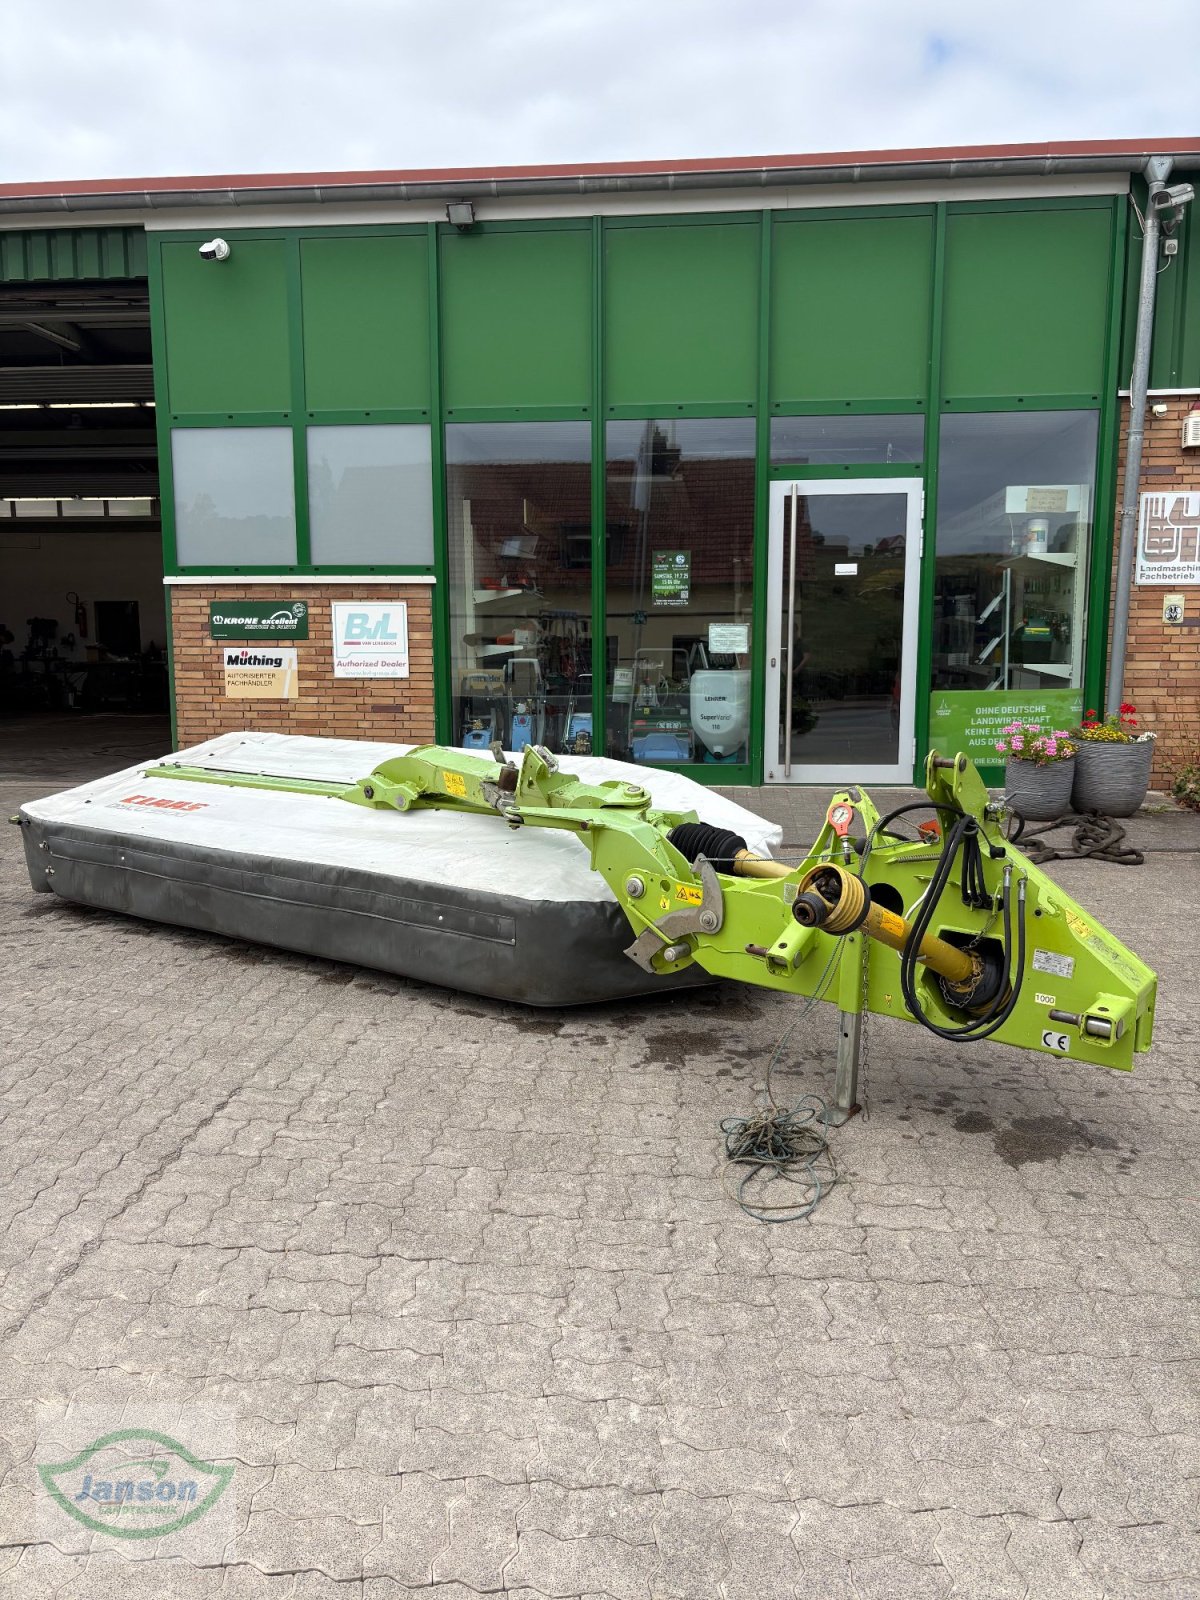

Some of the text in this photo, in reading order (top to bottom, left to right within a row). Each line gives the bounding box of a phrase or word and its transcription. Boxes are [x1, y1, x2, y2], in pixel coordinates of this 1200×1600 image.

[1140, 572, 1195, 580] Fachbetrieb
[224, 617, 298, 625] KRONE excellent
[344, 613, 398, 640] BvL
[227, 650, 283, 668] Müthing
[975, 705, 1047, 715] OHNE DEUTSCHE
[971, 715, 1052, 725] LANDWIRTSCHAFT
[965, 727, 991, 736] KEINE
[968, 738, 986, 746] AUS
[1035, 994, 1055, 1004] 1000
[1043, 1032, 1067, 1050] CE
